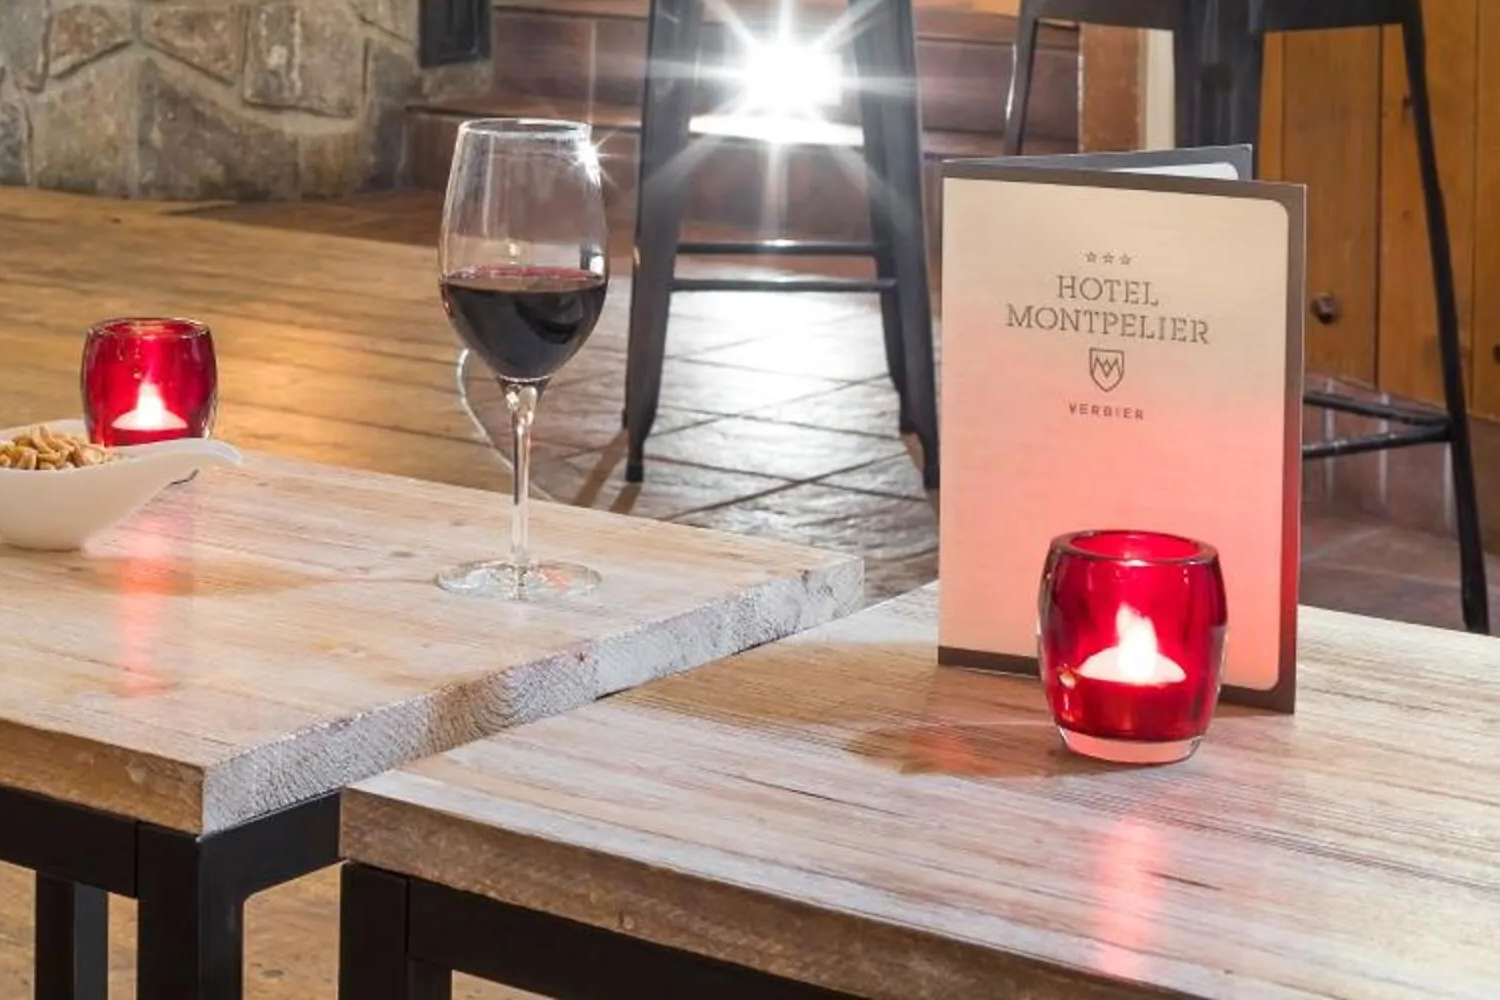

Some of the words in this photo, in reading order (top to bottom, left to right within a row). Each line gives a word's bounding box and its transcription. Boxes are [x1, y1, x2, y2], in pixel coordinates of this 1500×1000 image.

[1057, 274, 1160, 306] HOTEL
[1006, 304, 1210, 344] MONTPELIER
[1068, 402, 1144, 420] VERBIER
